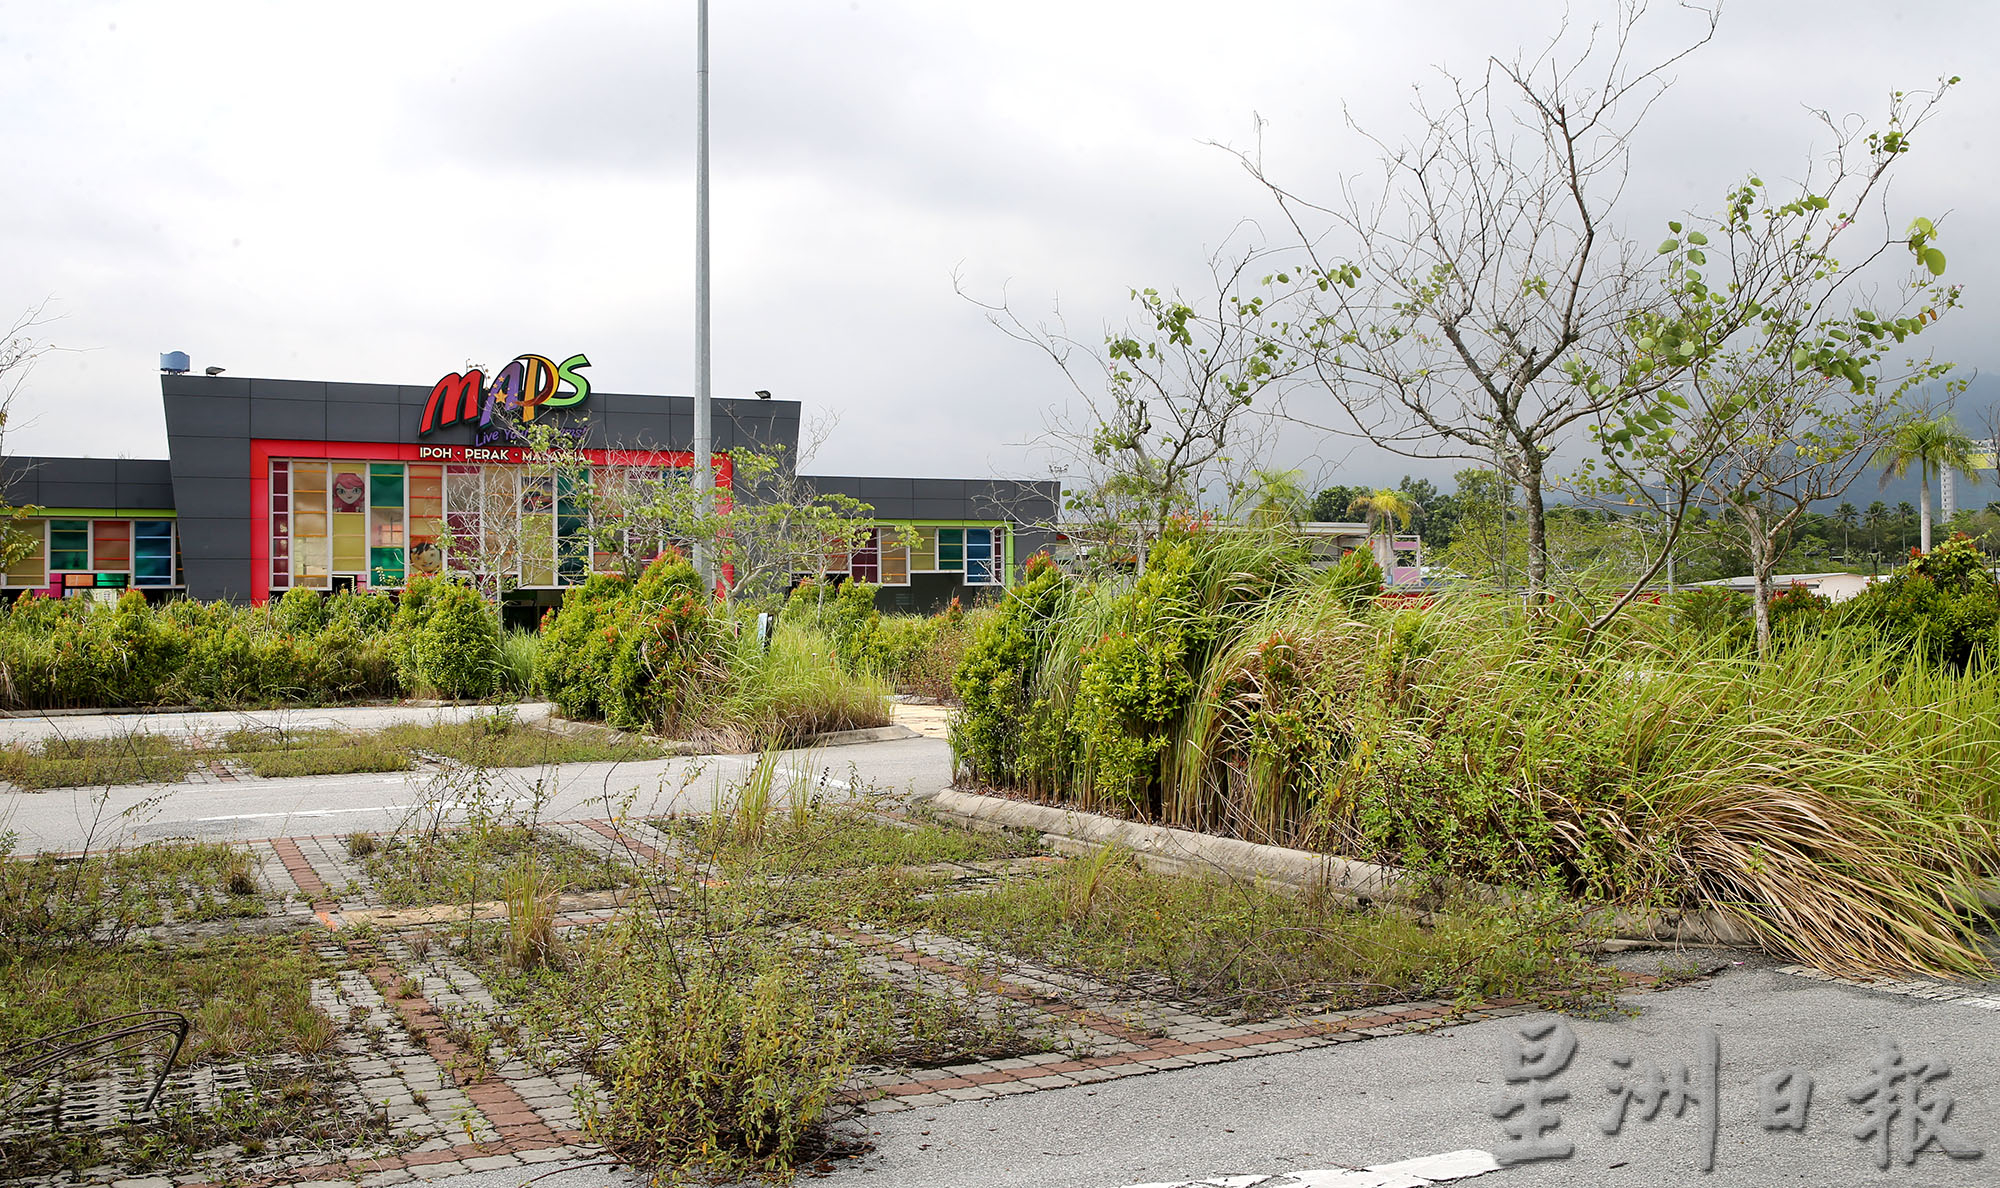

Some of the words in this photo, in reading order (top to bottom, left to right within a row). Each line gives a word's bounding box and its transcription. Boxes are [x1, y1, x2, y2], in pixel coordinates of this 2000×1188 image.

[419, 354, 591, 436] MAPS
[475, 430, 499, 447] Live
[419, 447, 452, 459] IPOH
[465, 448, 509, 460] PERAK
